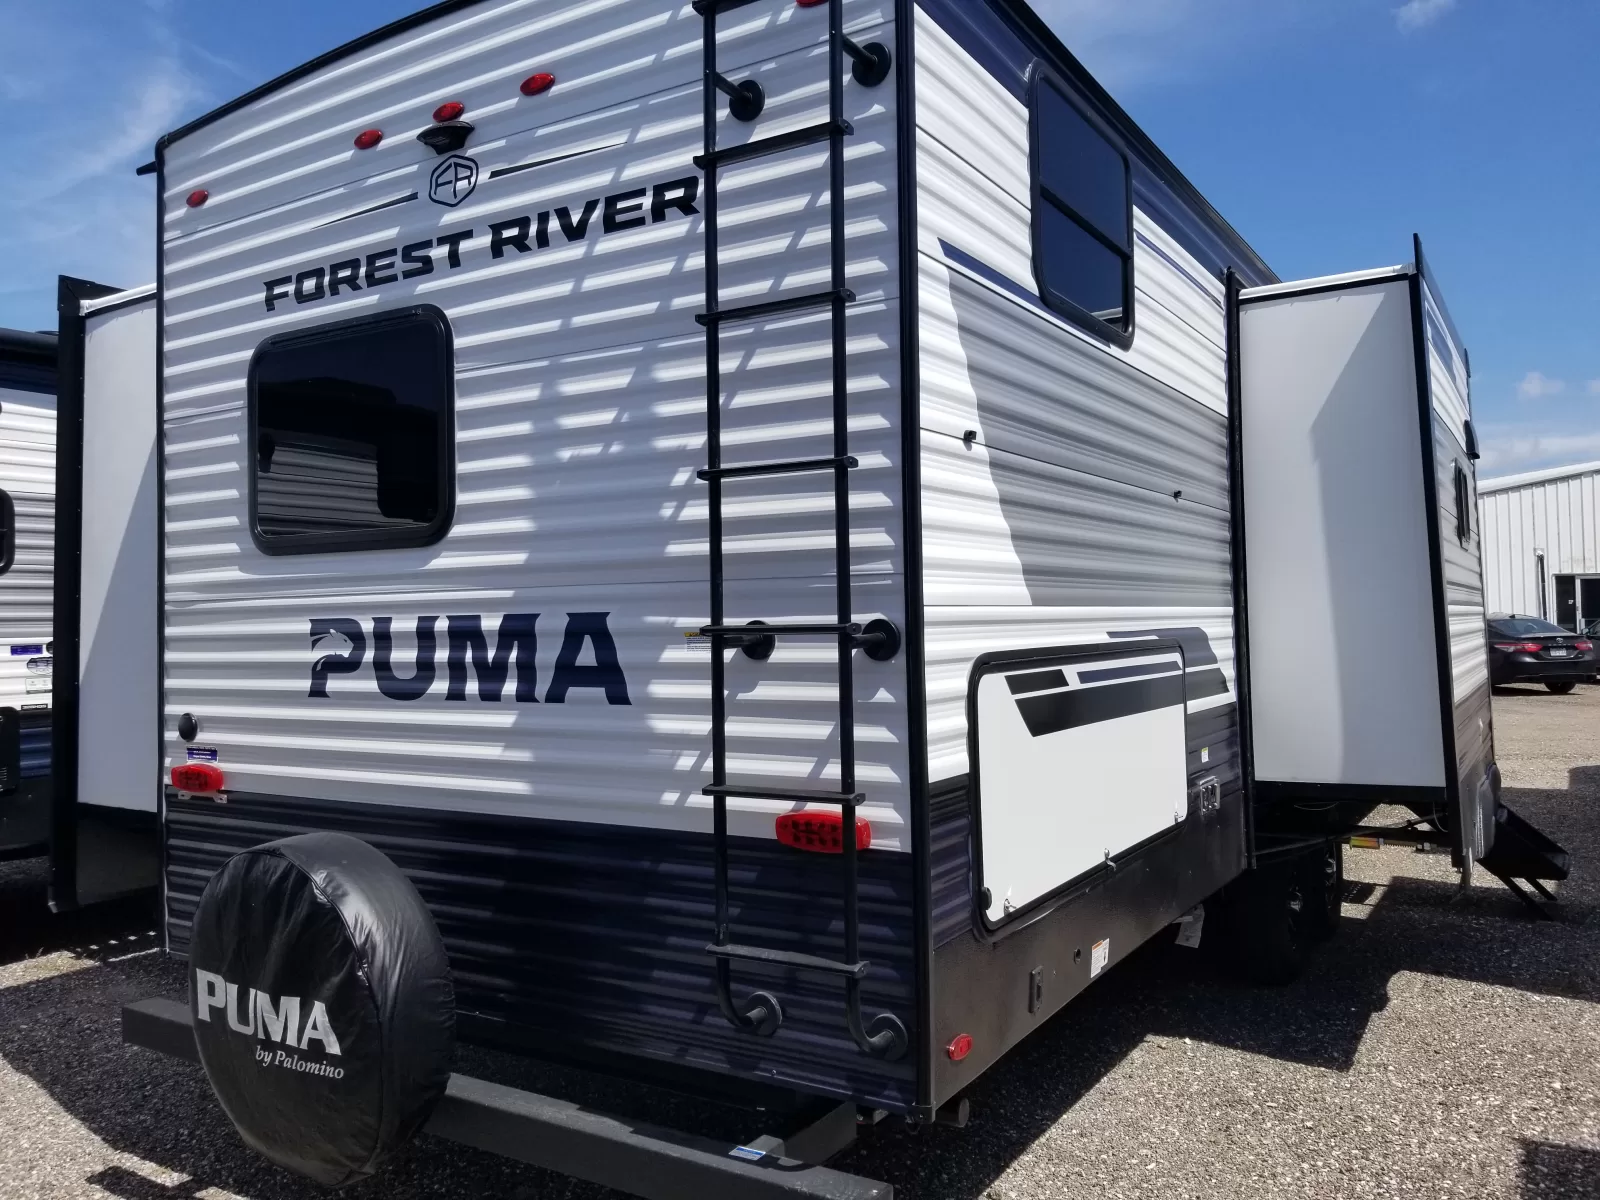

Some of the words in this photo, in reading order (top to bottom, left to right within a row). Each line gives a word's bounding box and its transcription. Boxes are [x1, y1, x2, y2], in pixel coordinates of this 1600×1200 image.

[263, 229, 474, 312] FOREST
[488, 175, 700, 259] RIVER
[308, 611, 633, 706] PUMA
[196, 967, 342, 1056] PUMA
[255, 1045, 273, 1067] by
[274, 1050, 345, 1079] Palomino
